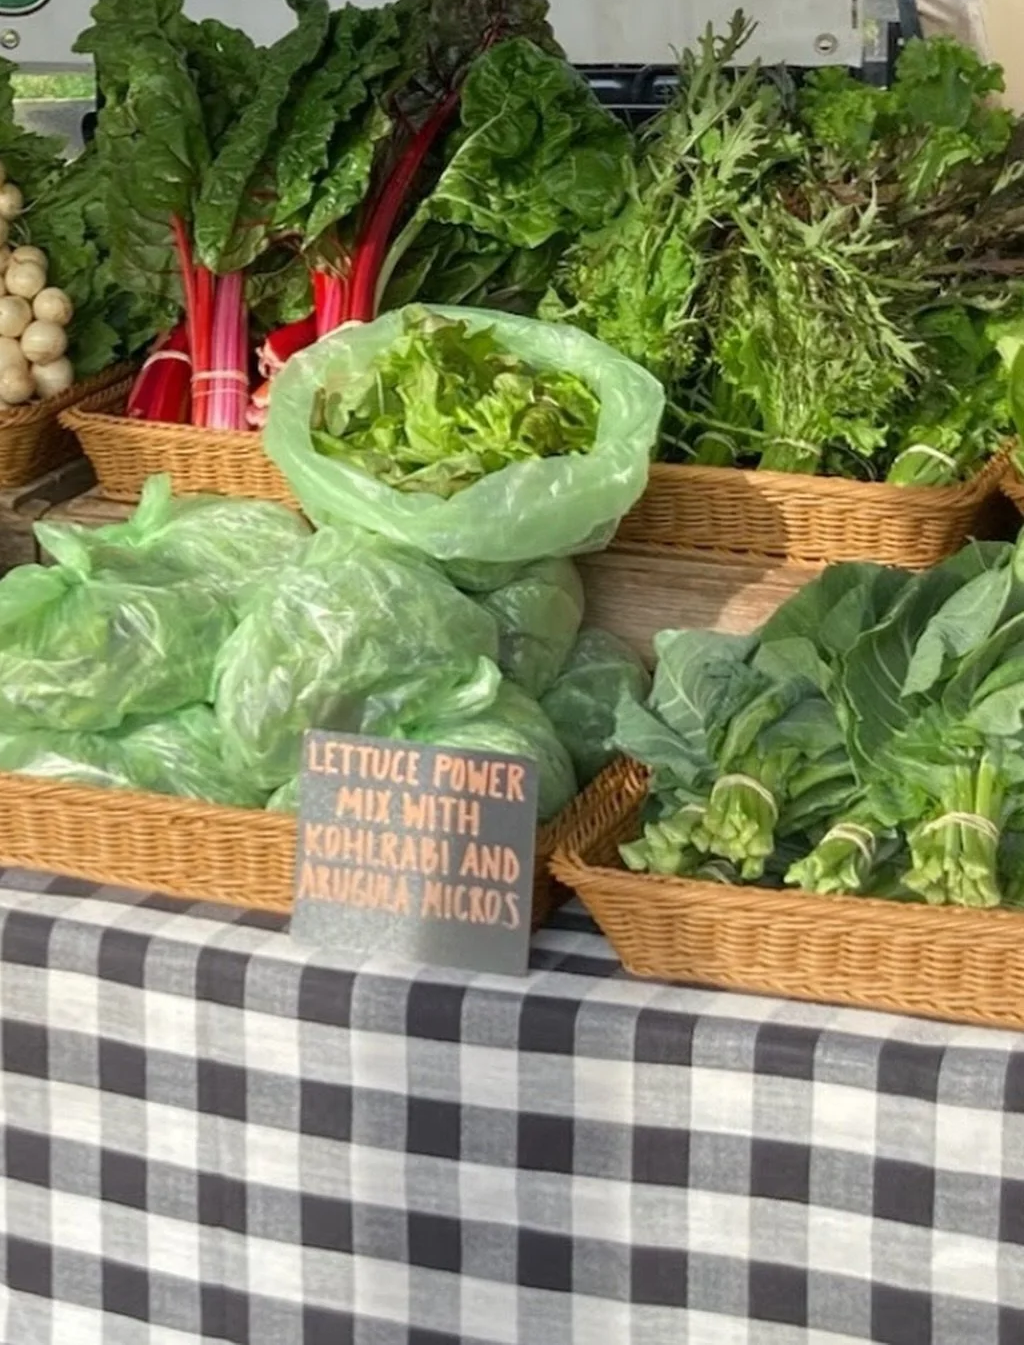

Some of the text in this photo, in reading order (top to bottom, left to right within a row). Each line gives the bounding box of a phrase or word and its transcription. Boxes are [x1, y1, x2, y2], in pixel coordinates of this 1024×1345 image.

[308, 738, 525, 802] LETTUCE POWER
[335, 785, 480, 835] MIX WITH
[304, 822, 520, 885] KOHLRABI AND
[297, 862, 521, 930] ARUGULA MICROS
